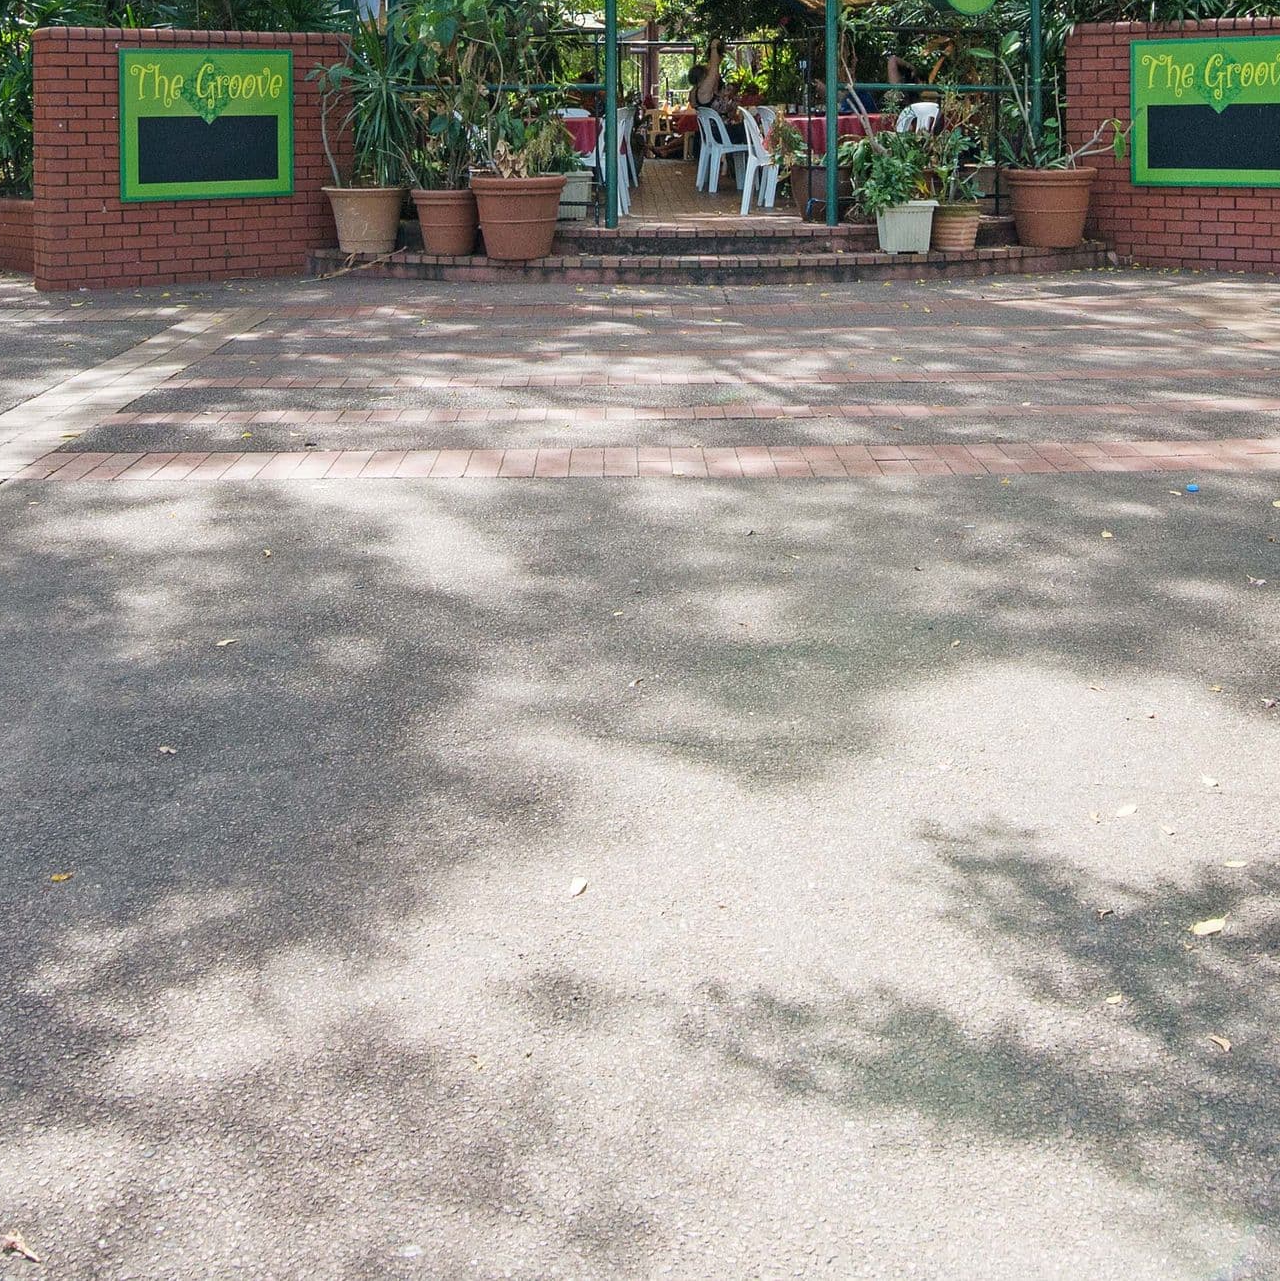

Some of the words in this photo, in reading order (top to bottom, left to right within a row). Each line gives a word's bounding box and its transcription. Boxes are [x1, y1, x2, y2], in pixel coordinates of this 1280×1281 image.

[130, 63, 184, 108] The
[196, 63, 283, 109] Groove
[1141, 54, 1194, 98] The
